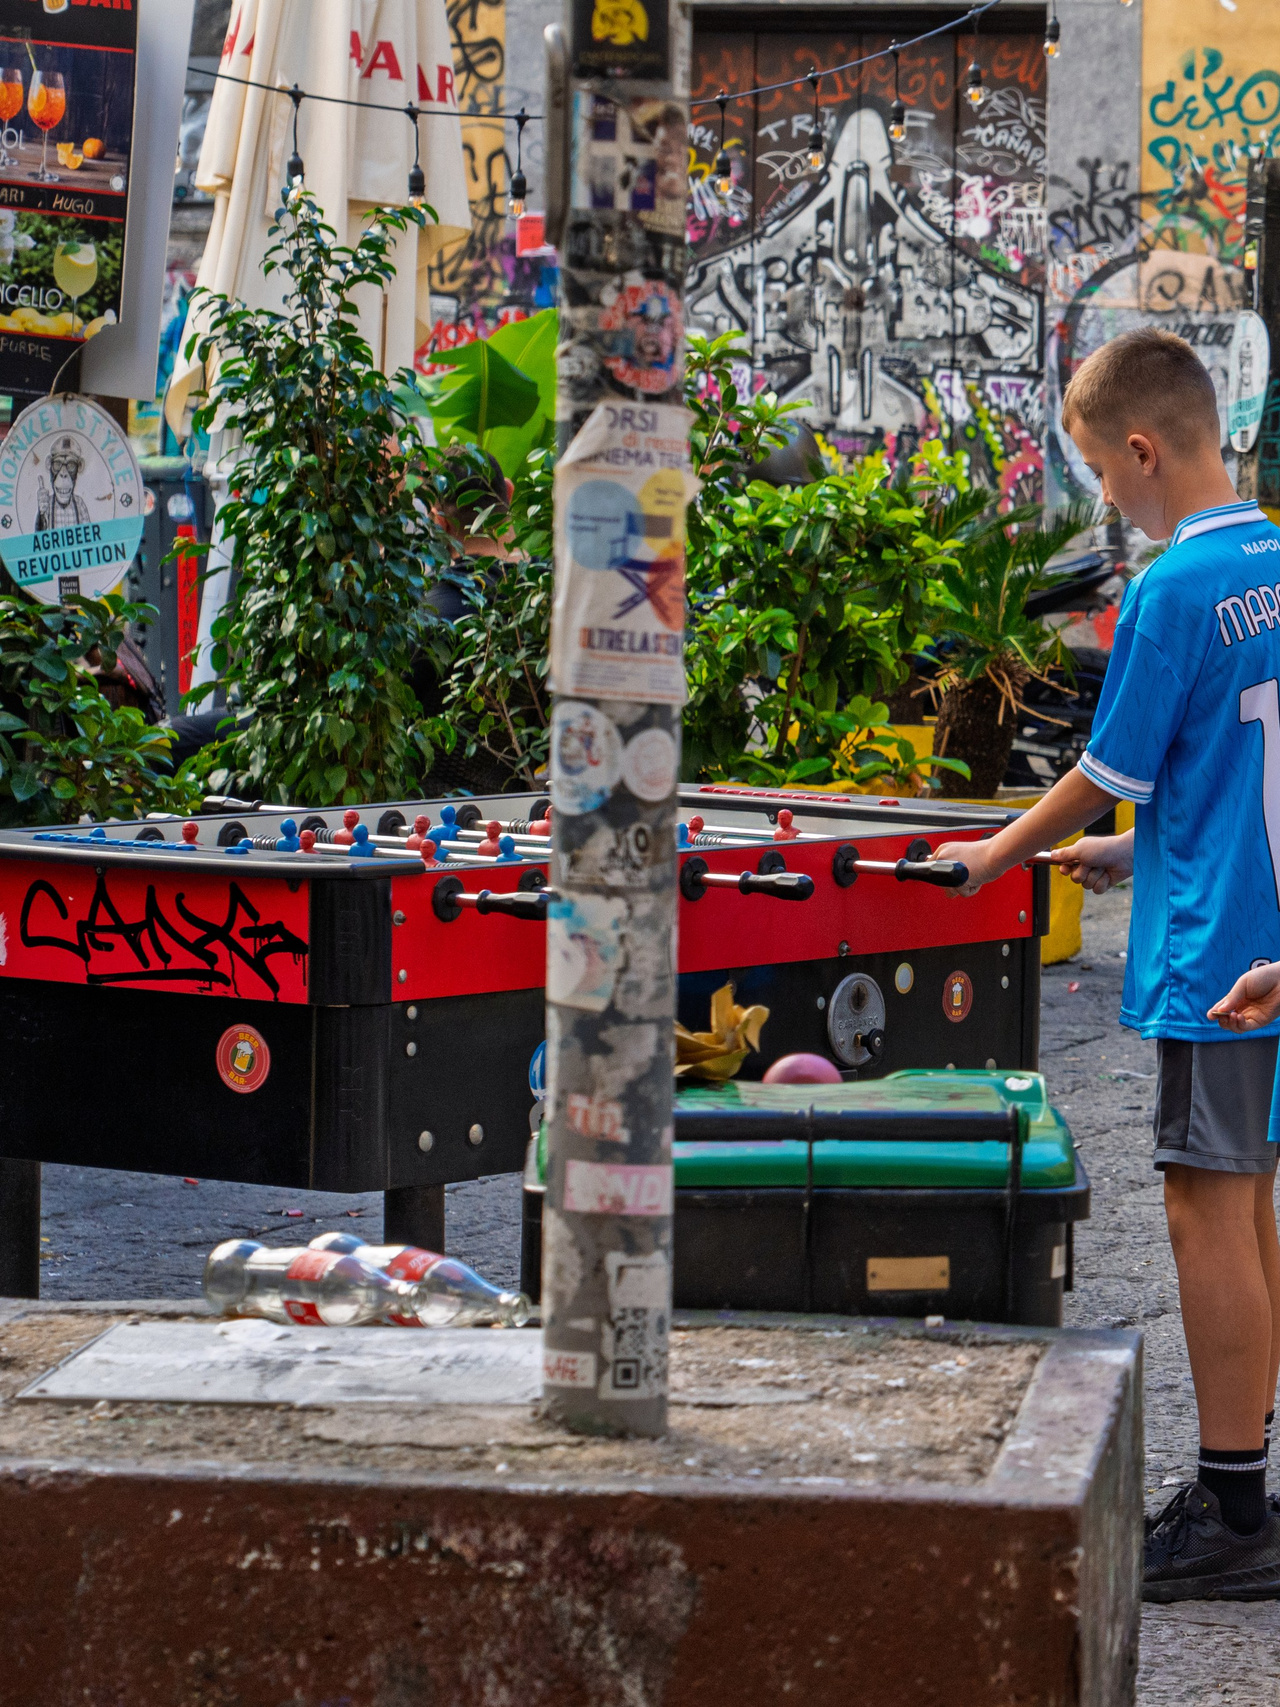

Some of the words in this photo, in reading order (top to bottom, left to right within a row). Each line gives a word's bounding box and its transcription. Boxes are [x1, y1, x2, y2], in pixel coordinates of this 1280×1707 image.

[0, 127, 26, 150] OL
[52, 194, 95, 214] HUGO
[0, 404, 63, 507] MONKEY
[76, 404, 134, 486] STYLE
[33, 524, 102, 552] AGRIBEER
[18, 543, 127, 578] REVOLUTION
[238, 1032, 260, 1049] BEER
[228, 1070, 247, 1086] BAR
